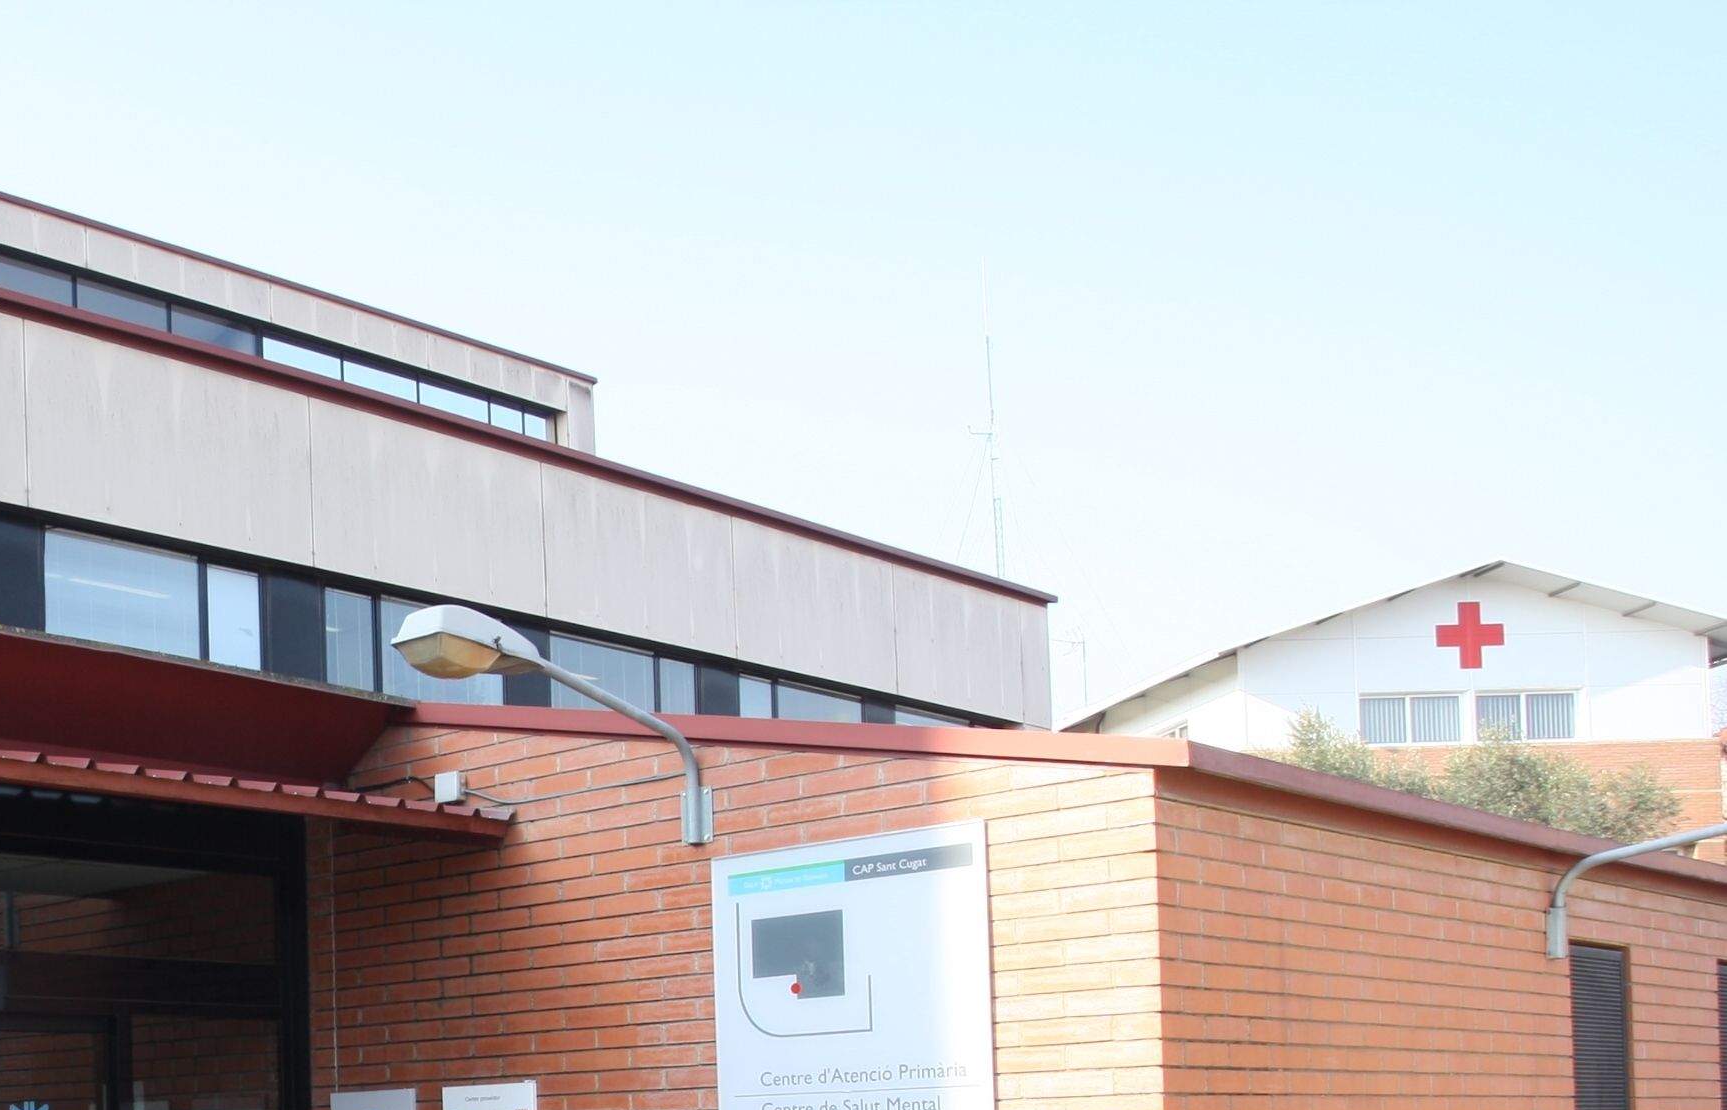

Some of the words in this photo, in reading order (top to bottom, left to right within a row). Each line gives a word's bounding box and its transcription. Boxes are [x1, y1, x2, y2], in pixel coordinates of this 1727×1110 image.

[852, 863, 875, 876] CAP
[876, 861, 897, 873] Sant
[899, 857, 927, 871] Cugat
[760, 1072, 813, 1087] Centre
[818, 1068, 893, 1084] d'Atenció
[899, 1063, 967, 1080] Primària
